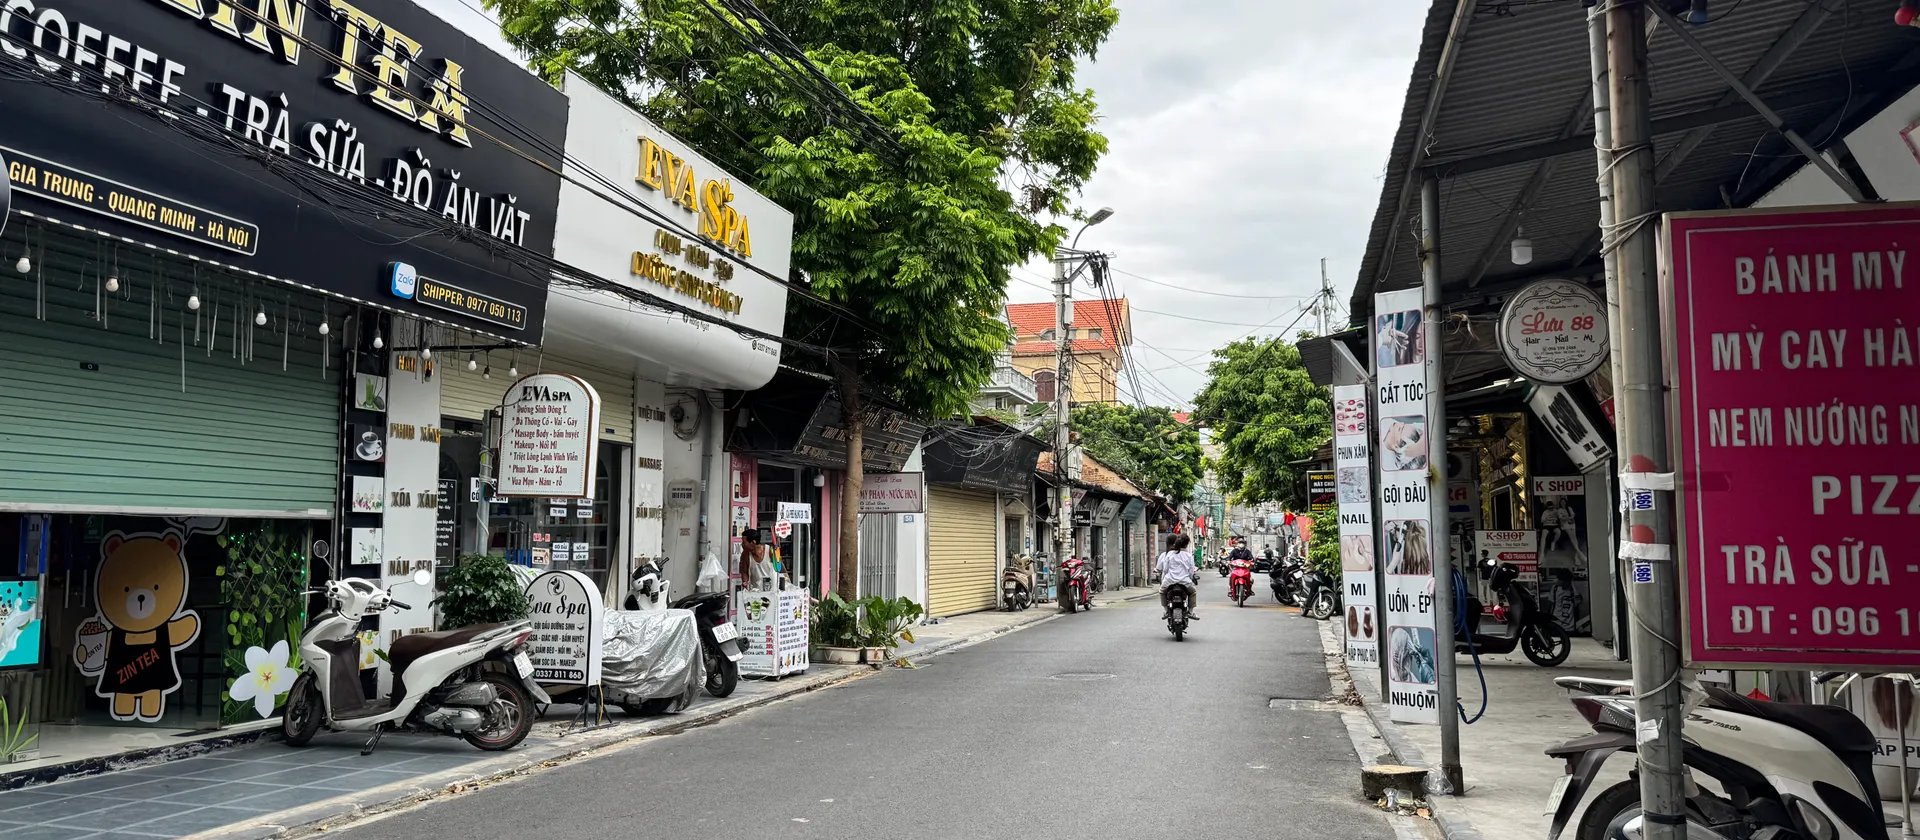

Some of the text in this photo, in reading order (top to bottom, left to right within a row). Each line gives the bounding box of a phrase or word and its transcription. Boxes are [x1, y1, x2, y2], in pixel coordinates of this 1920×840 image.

[328, 0, 472, 148] TEA
[222, 83, 290, 156] TRÀ
[307, 118, 366, 185] SỮA
[393, 147, 433, 211] ĐỒ
[442, 168, 480, 228] ĂN
[635, 136, 752, 258] EVA SPA
[9, 161, 250, 250] GIA TRUNG QUANG MINH HÀ NỘI
[1735, 242, 1906, 295] BÁNH MỲ
[398, 273, 414, 286] Zalo
[423, 283, 521, 323] SHIPPER: 0977 050 113
[1521, 311, 1594, 335] Lưu 88
[1555, 334, 1568, 343] Nail
[1711, 318, 1920, 371] MỲ CAY HÀ
[522, 386, 571, 401] EVA SPA
[1380, 380, 1424, 404] CẮT TÓC
[535, 404, 546, 414] Sinh
[524, 417, 541, 427] Thông
[554, 416, 562, 426] Vai
[1709, 407, 1773, 447] NEM
[1784, 397, 1888, 446] NƯỚNG
[389, 423, 415, 440] PHUN
[515, 428, 535, 439] Massage
[536, 429, 549, 439] Body
[514, 440, 534, 450] Makeup
[527, 452, 539, 463] Lông
[540, 453, 552, 463] Lạnh
[1337, 447, 1354, 460] PHUN
[512, 464, 525, 474] Phun
[638, 456, 662, 471] MASSAGE
[889, 487, 904, 499] NƯỚC
[905, 490, 917, 499] HOA
[1535, 480, 1583, 491] K SHOP
[391, 488, 411, 508] XÓA
[1383, 481, 1427, 506] GỘI ĐẦU
[1341, 514, 1369, 524] NAIL
[1486, 532, 1525, 542] K-SHOP
[1720, 536, 1890, 585] TRÀ SỮA
[1350, 583, 1366, 596] MI
[556, 594, 587, 619] Spa
[1388, 587, 1431, 613] UỐN ÉP
[565, 622, 576, 631] SINH
[1731, 605, 1774, 634] ĐT
[1812, 606, 1880, 636] 096
[541, 632, 551, 642] GIÁC
[94, 643, 103, 653] TEA
[117, 648, 160, 684] ZIN TEA
[541, 657, 551, 667] SÓC
[551, 659, 556, 667] DA
[560, 659, 577, 668] MAKEUP
[536, 669, 582, 679] 0337 811 868
[1392, 691, 1435, 710] NHUỘM
[1874, 739, 1897, 756] ẤP
